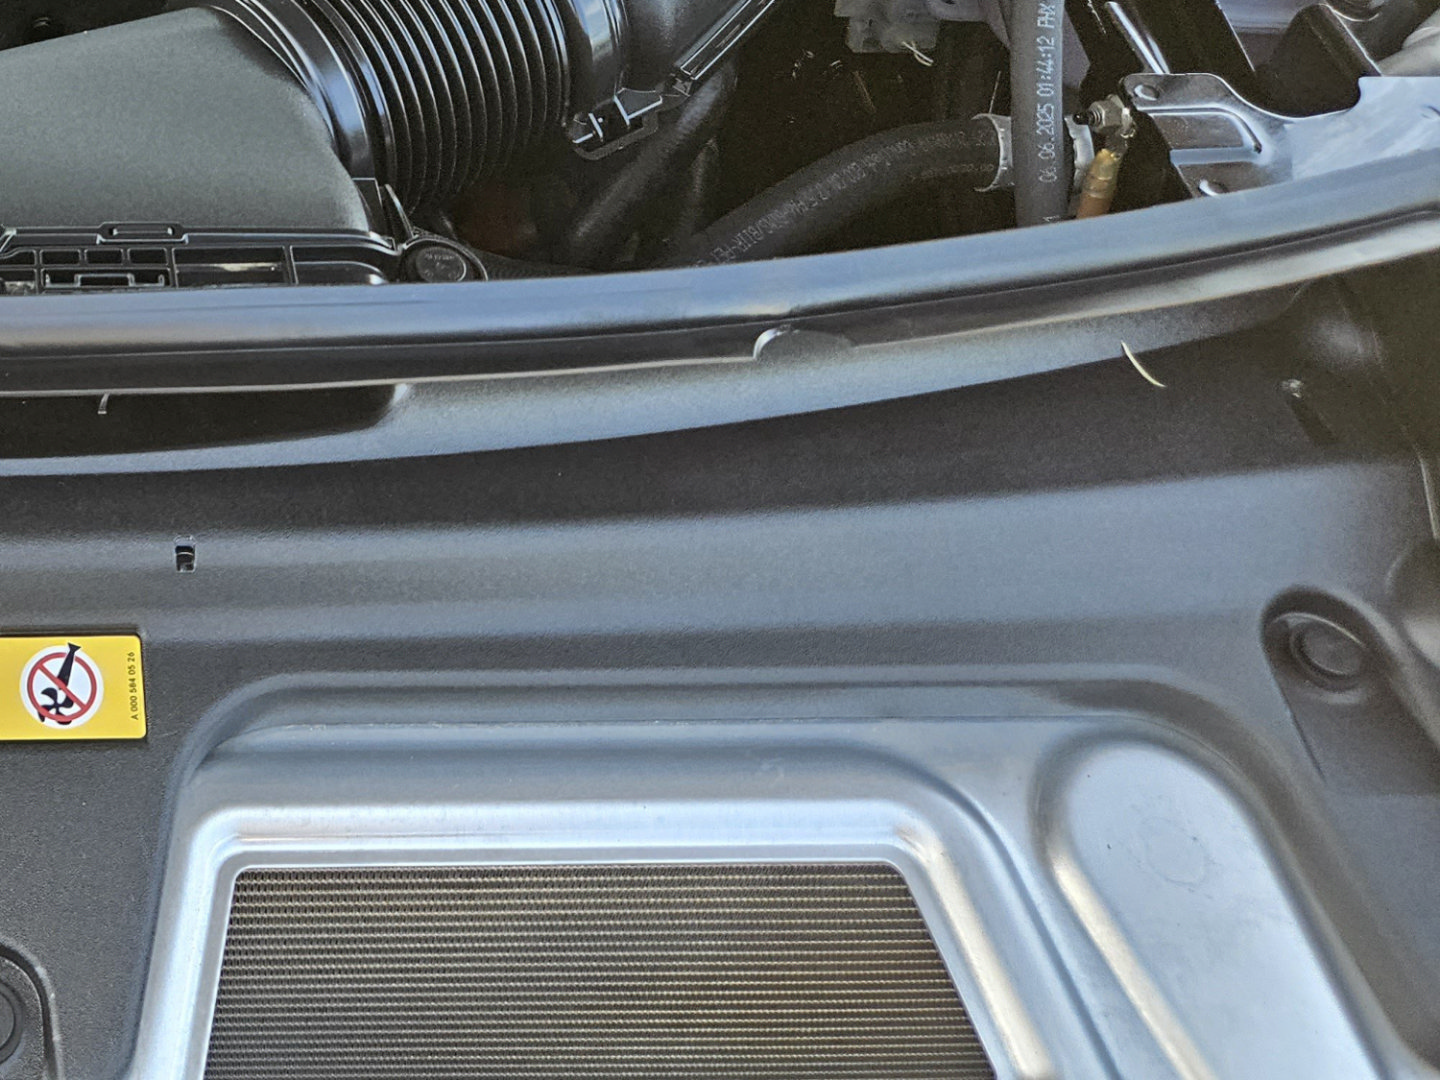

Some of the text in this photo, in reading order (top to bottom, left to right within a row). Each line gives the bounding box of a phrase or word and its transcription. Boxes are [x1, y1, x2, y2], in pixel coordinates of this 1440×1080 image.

[1035, 35, 1055, 97] 01:44:12
[127, 652, 135, 662] 26
[127, 664, 136, 676] 05
[128, 678, 137, 693] 584
[130, 695, 138, 712] 000
